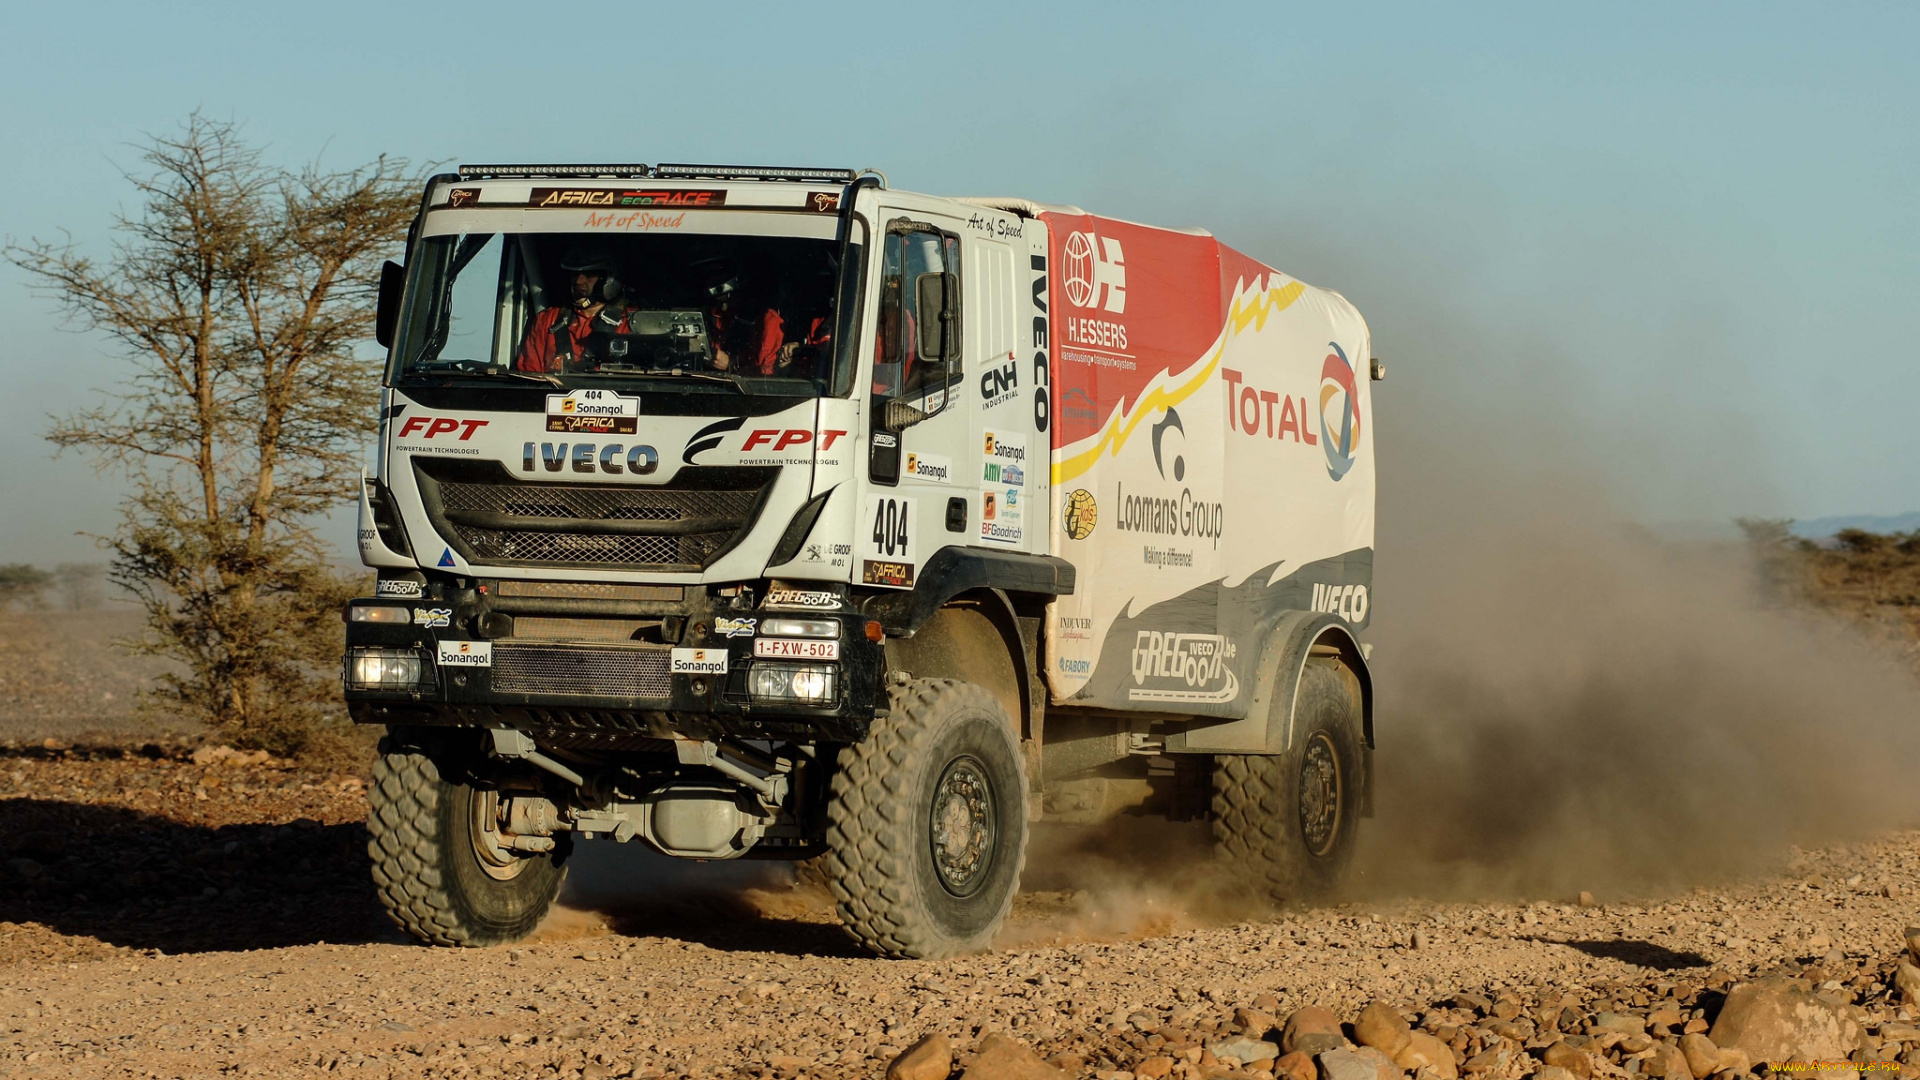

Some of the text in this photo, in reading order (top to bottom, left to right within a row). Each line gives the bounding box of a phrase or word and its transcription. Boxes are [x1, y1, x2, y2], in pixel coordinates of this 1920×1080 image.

[540, 191, 614, 207] AFRICA
[584, 212, 685, 231] Art of Speed
[967, 213, 1023, 239] Art of Speed
[1030, 254, 1049, 432] IVECO
[1068, 317, 1128, 350] H.ESSERS
[981, 361, 1018, 400] CNH
[584, 390, 602, 400] 404
[982, 390, 1019, 411] INDUSTRIAL
[576, 403, 624, 415] Sonangol
[1221, 367, 1317, 446] TOTAL
[398, 417, 490, 441] FPT
[570, 417, 615, 428] AFRICA
[396, 445, 480, 455] POWERTRAIN TECHNOLOGIES
[740, 429, 848, 452] FPT
[522, 441, 660, 476] IVECO
[994, 441, 1026, 463] Sonangol
[916, 460, 948, 482] Sonangol
[1116, 481, 1223, 551] Loomans Group
[872, 498, 908, 557] 404
[981, 522, 1022, 540] BFGoodrich
[830, 558, 845, 567] MOL
[877, 563, 906, 579] AFRICA
[1310, 583, 1368, 623] IVECO
[440, 652, 489, 665] Sonangol
[758, 642, 835, 657] 1-FXW-502
[1190, 643, 1213, 655] IVECO
[674, 660, 725, 674] Sonangol
[1065, 659, 1090, 673] FABORY
